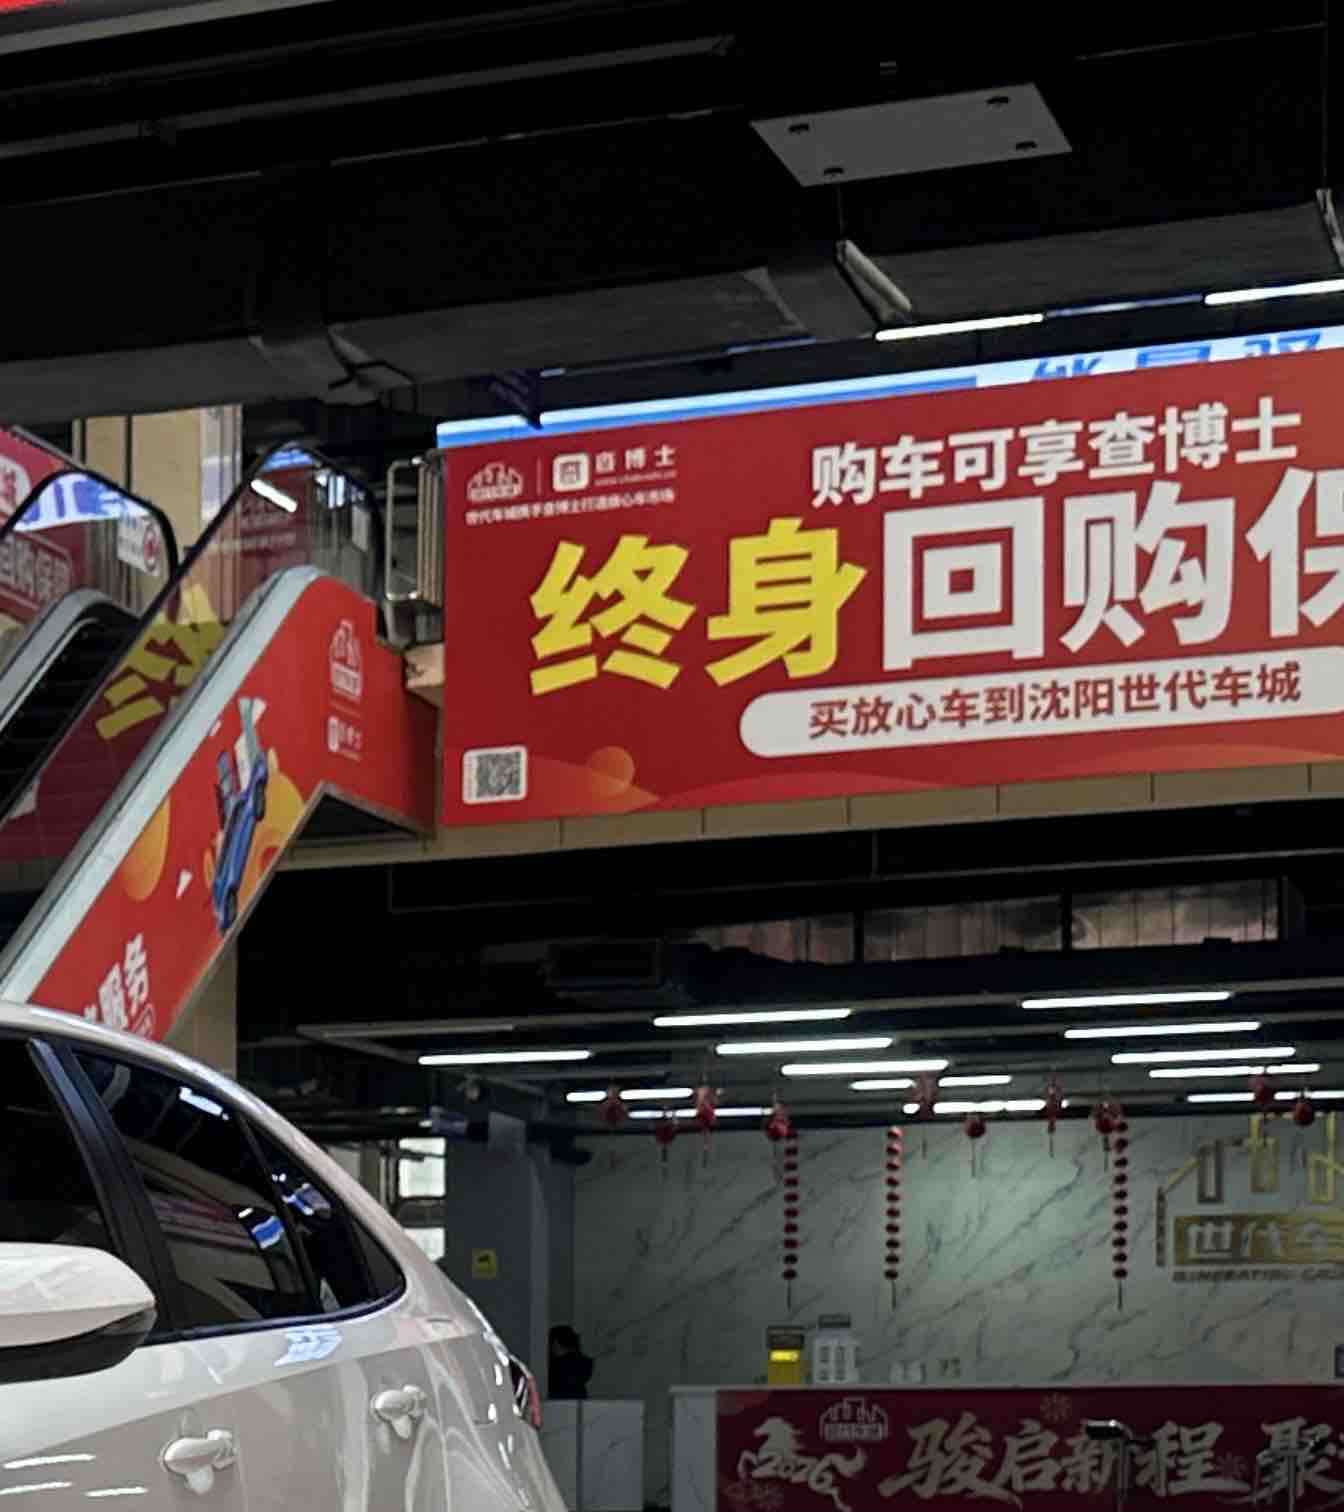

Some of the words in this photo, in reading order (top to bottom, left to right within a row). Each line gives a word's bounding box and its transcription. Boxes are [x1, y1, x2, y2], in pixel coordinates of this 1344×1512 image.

[812, 397, 1301, 508] 购车可享查博士
[809, 660, 1303, 738] 买放心车到沈阳世代车城
